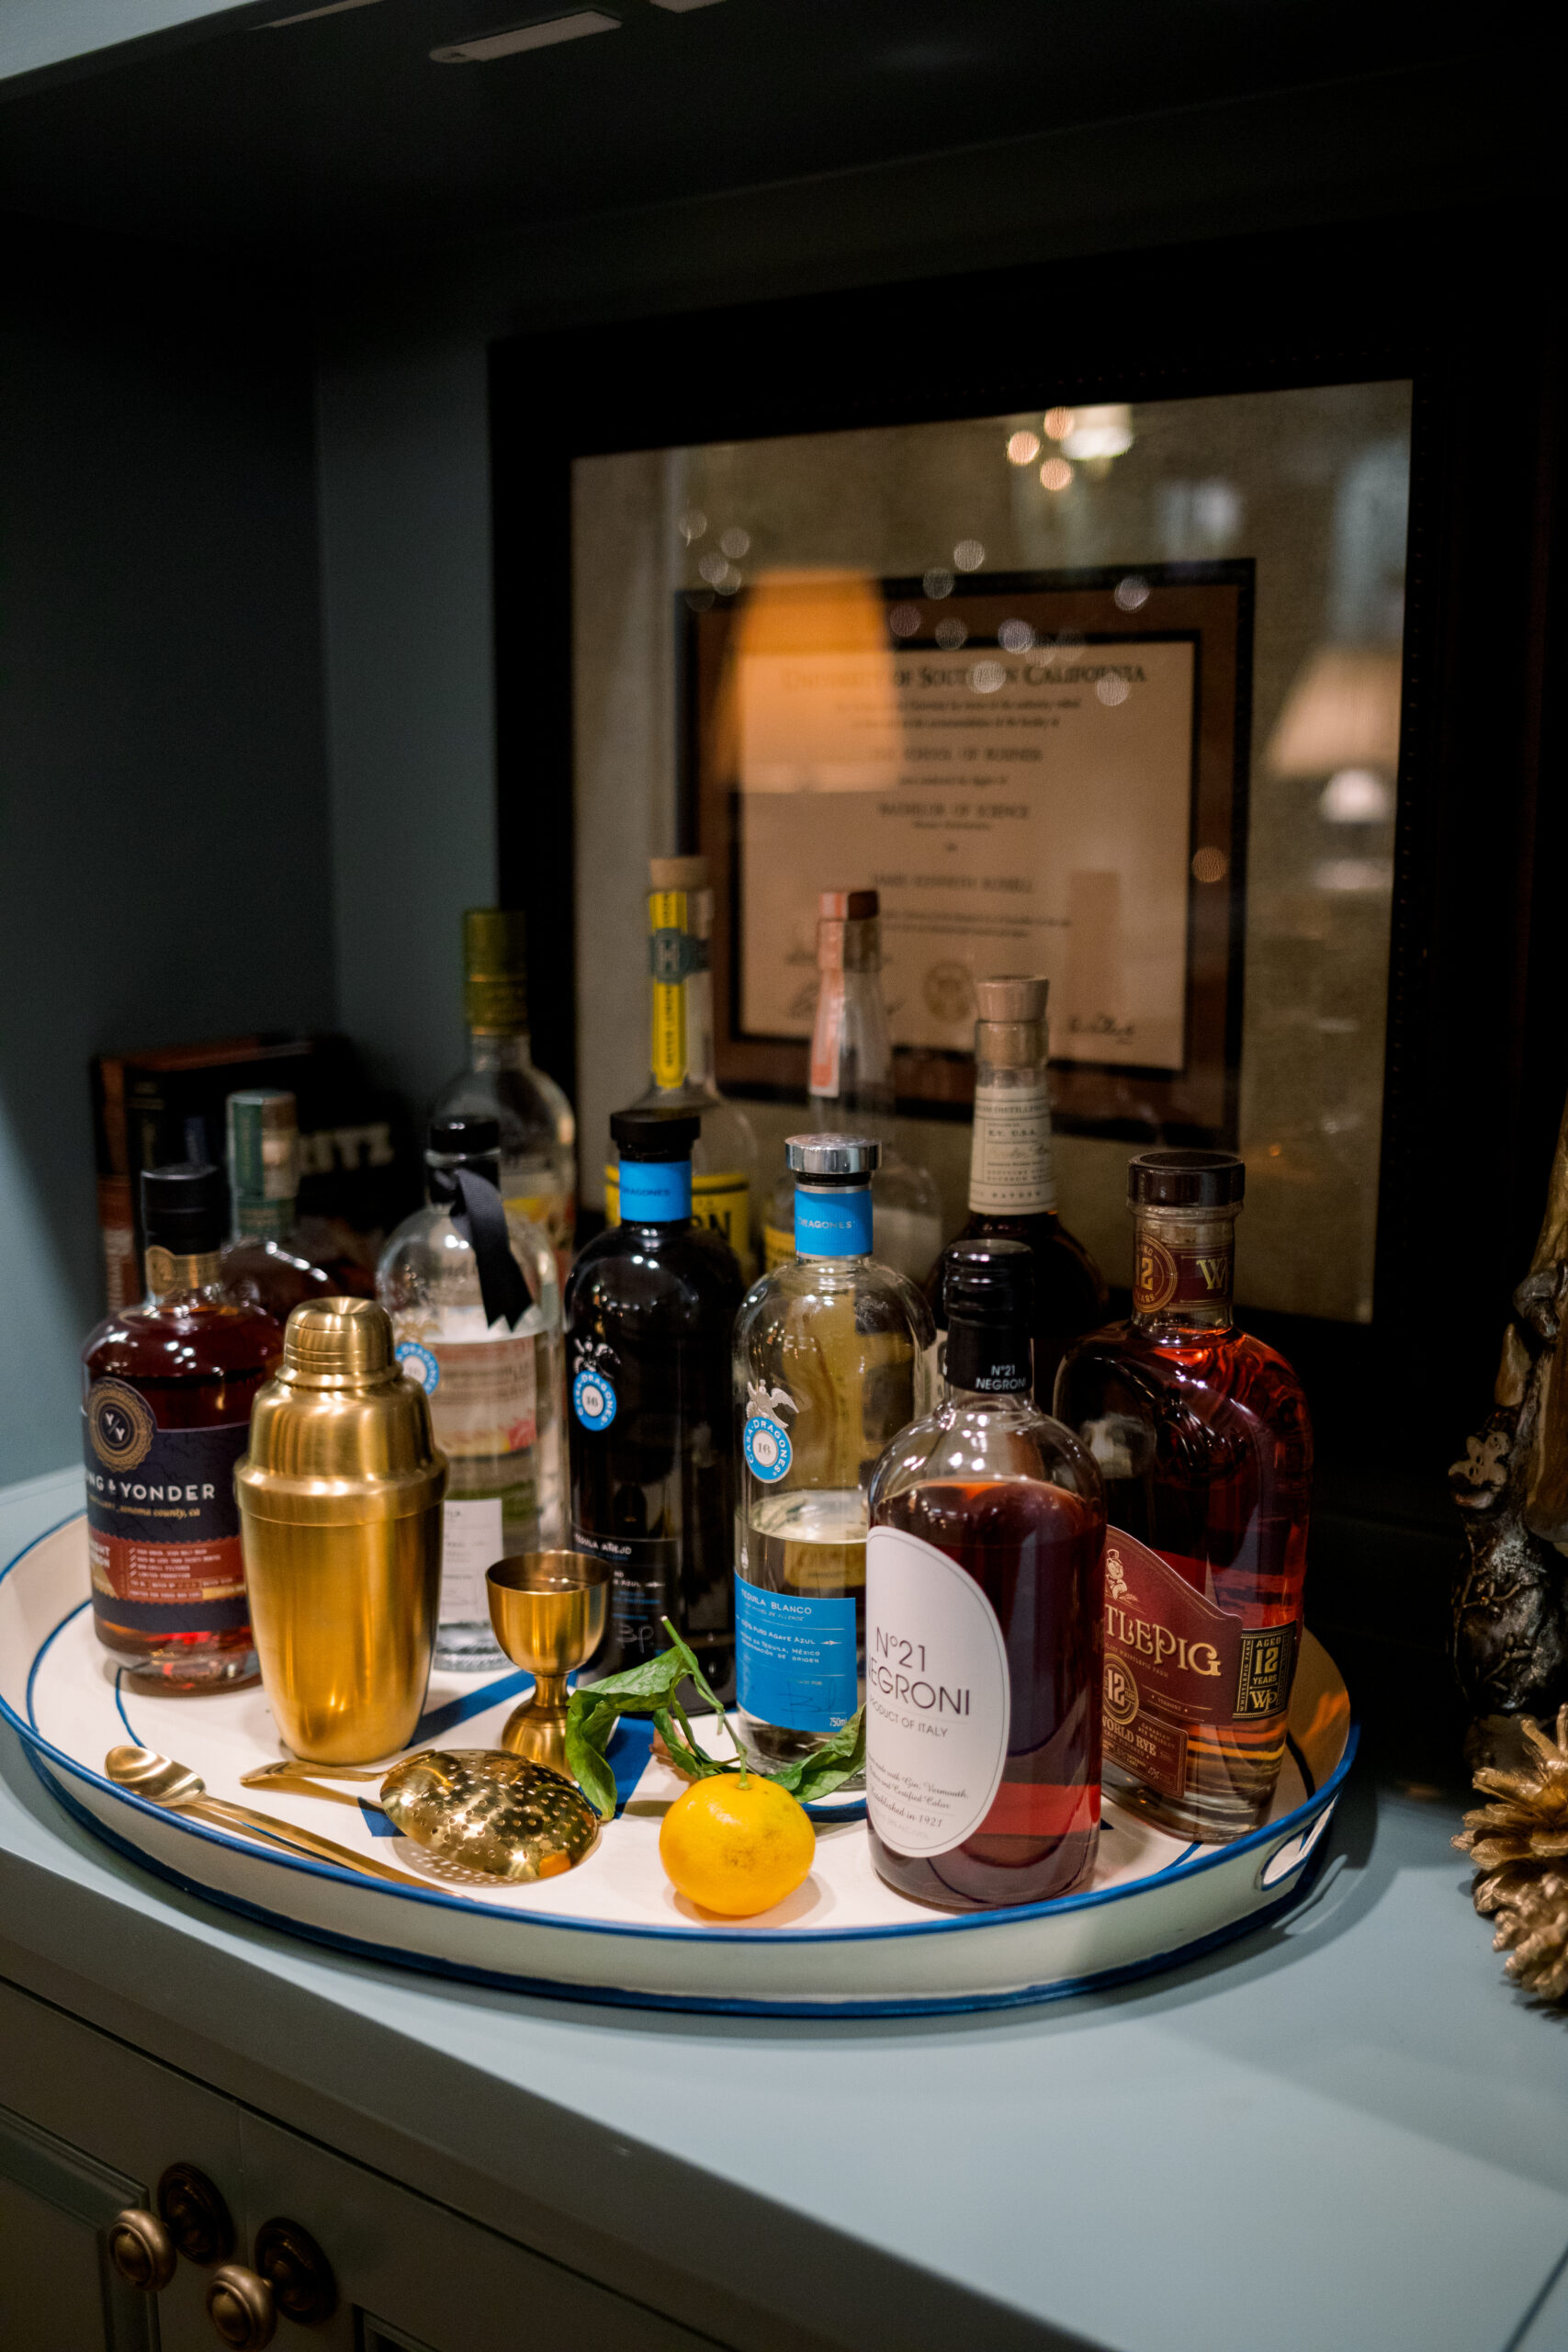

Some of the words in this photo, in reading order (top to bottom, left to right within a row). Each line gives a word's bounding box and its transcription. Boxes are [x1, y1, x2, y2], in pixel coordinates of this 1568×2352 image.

[752, 1419, 788, 1473] DRAGONES
[119, 1481, 216, 1503] YONDER
[740, 1588, 766, 1607] TEQUILA
[770, 1601, 813, 1615] BLANCO
[768, 1632, 792, 1642] AGAVE
[794, 1636, 816, 1645] AZUL
[1256, 1635, 1282, 1648] AGED
[791, 1647, 820, 1657] MÉXICO
[791, 1656, 820, 1664] ORIGEN
[1254, 1645, 1280, 1675] 12
[1107, 1668, 1126, 1707] 12
[1240, 1664, 1249, 1712] WHISTLEPIG
[1253, 1674, 1278, 1685] YEARS
[901, 1716, 916, 1730] OF
[918, 1722, 949, 1738] ITALY
[1135, 1734, 1157, 1757] RYE
[906, 1813, 916, 1821] in
[918, 1814, 943, 1828] 1921
